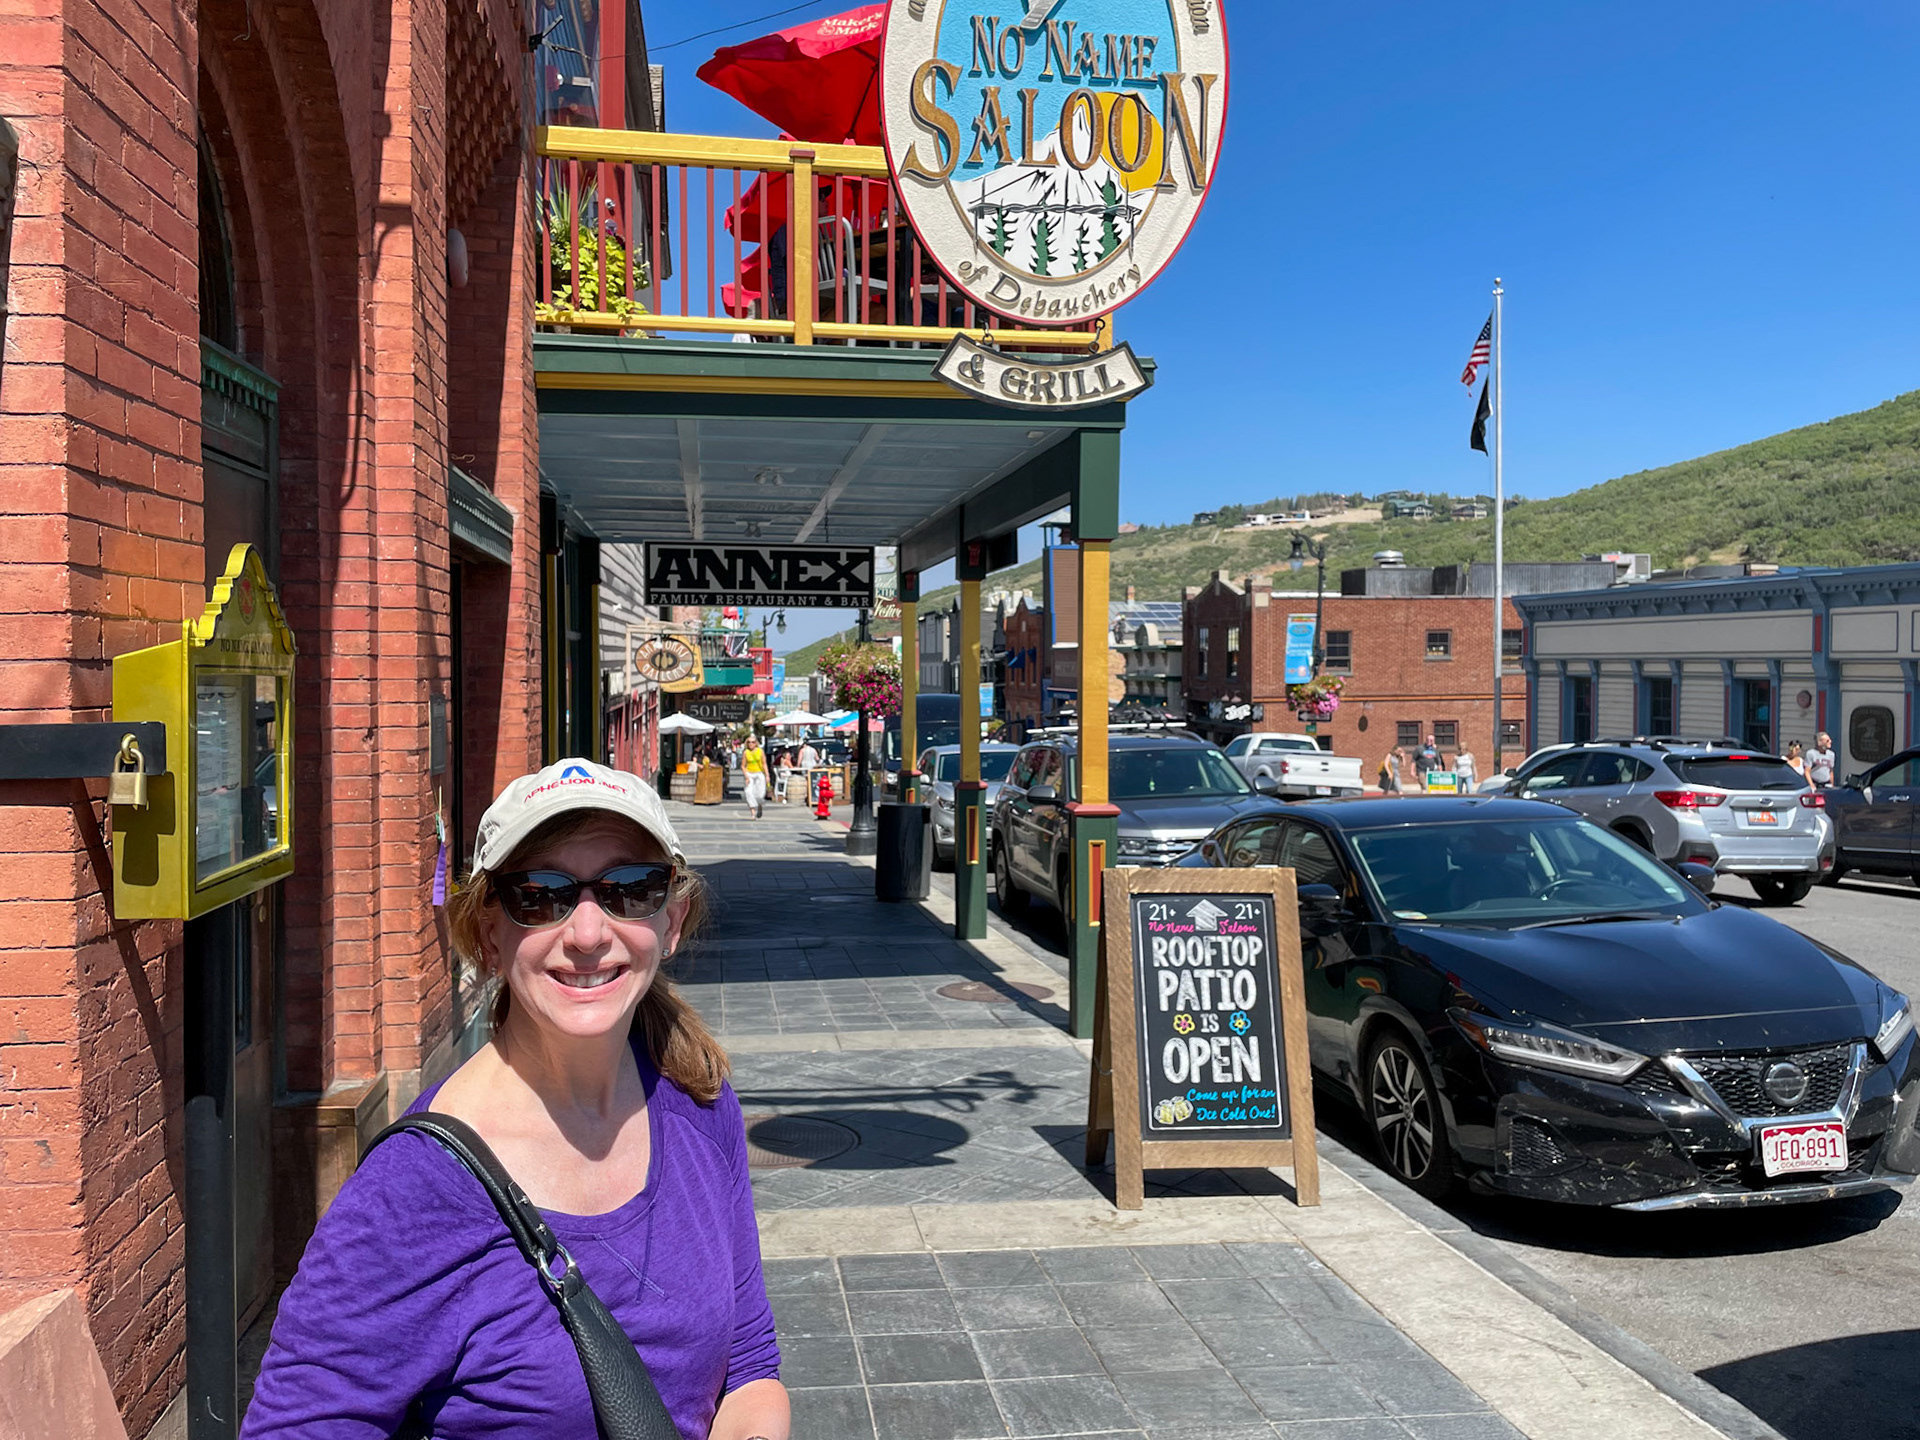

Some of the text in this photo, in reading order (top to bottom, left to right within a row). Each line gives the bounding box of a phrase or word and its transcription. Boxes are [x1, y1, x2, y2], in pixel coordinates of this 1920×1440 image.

[822, 12, 882, 26] Maker's
[834, 22, 879, 35] Mark
[969, 15, 1159, 86] NO NAME
[899, 58, 1217, 191] SALOON
[958, 260, 1143, 316] of Debauchery
[957, 354, 1125, 402] & GRILL
[650, 548, 869, 591] ANNEX
[650, 594, 869, 607] FAMILY RESTAURANT & BAR
[690, 704, 718, 718] 501
[524, 778, 595, 803] APHELION
[1219, 919, 1258, 935] Saloon
[1152, 935, 1263, 967] ROOFTOP
[1157, 969, 1257, 1012] PATIO
[1200, 1013, 1220, 1033] IS
[1162, 1035, 1261, 1084] OPEN
[1186, 1088, 1218, 1102] Come
[1221, 1090, 1239, 1104] up
[1219, 1106, 1248, 1121] Cold
[1249, 1104, 1276, 1120] One!
[1781, 1159, 1823, 1169] COLORADO
